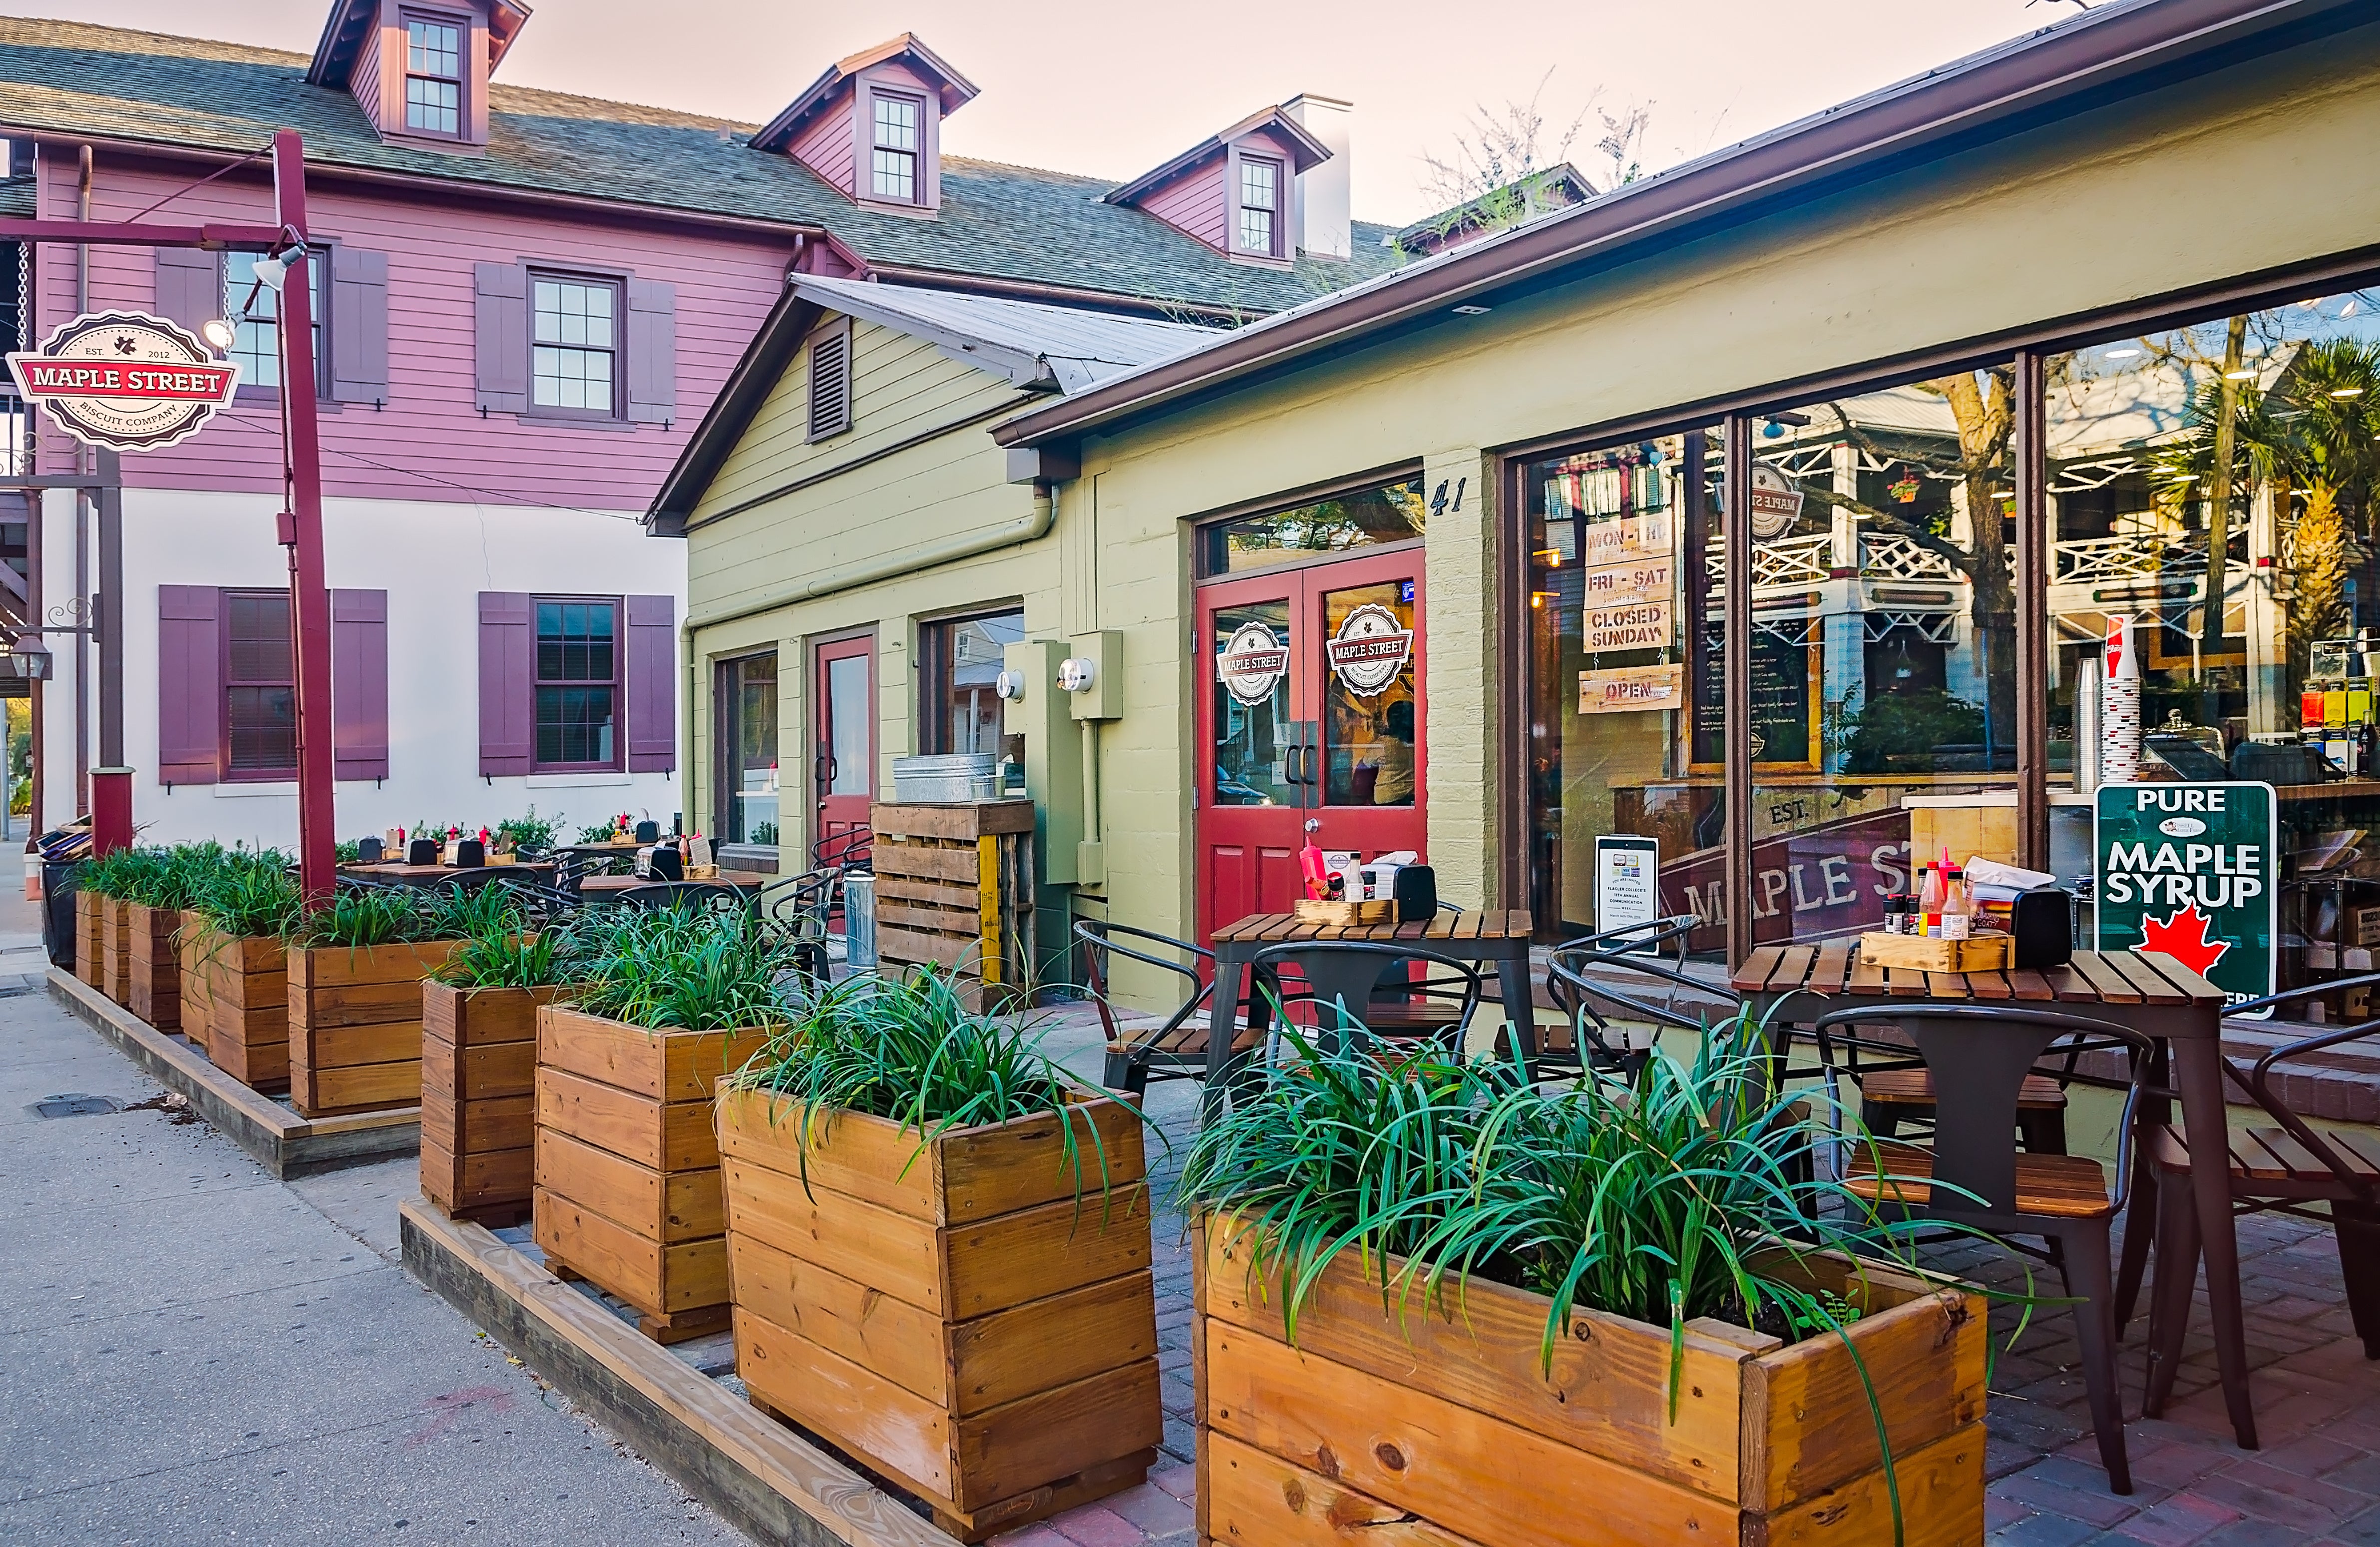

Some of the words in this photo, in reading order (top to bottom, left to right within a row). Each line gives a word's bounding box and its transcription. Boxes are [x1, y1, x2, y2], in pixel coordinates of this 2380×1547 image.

[33, 367, 121, 389] MAPLE
[128, 372, 221, 393] STREET
[80, 402, 122, 425] BISCUIT
[126, 405, 178, 426] COMPANY
[1430, 478, 1466, 516] 41
[1588, 530, 1624, 549] MON
[1589, 574, 1613, 591] FRI
[1634, 568, 1666, 585] SAT
[1592, 607, 1660, 628] CLOSED
[1592, 626, 1661, 646] SUNDAY
[1335, 645, 1367, 659] MAPLE
[1368, 639, 1404, 655] STREET
[1224, 658, 1250, 671] MAPLE
[1251, 655, 1282, 669] STREET
[1351, 667, 1367, 680] BISCUIT
[1367, 663, 1387, 680] COMPANY
[1606, 681, 1651, 698] OPEN
[1769, 799, 1809, 825] EST.
[2137, 790, 2225, 812] PURE
[2107, 842, 2260, 875] MAPLE
[1684, 855, 1856, 928] MPLE
[2106, 872, 2262, 908] SYRUP
